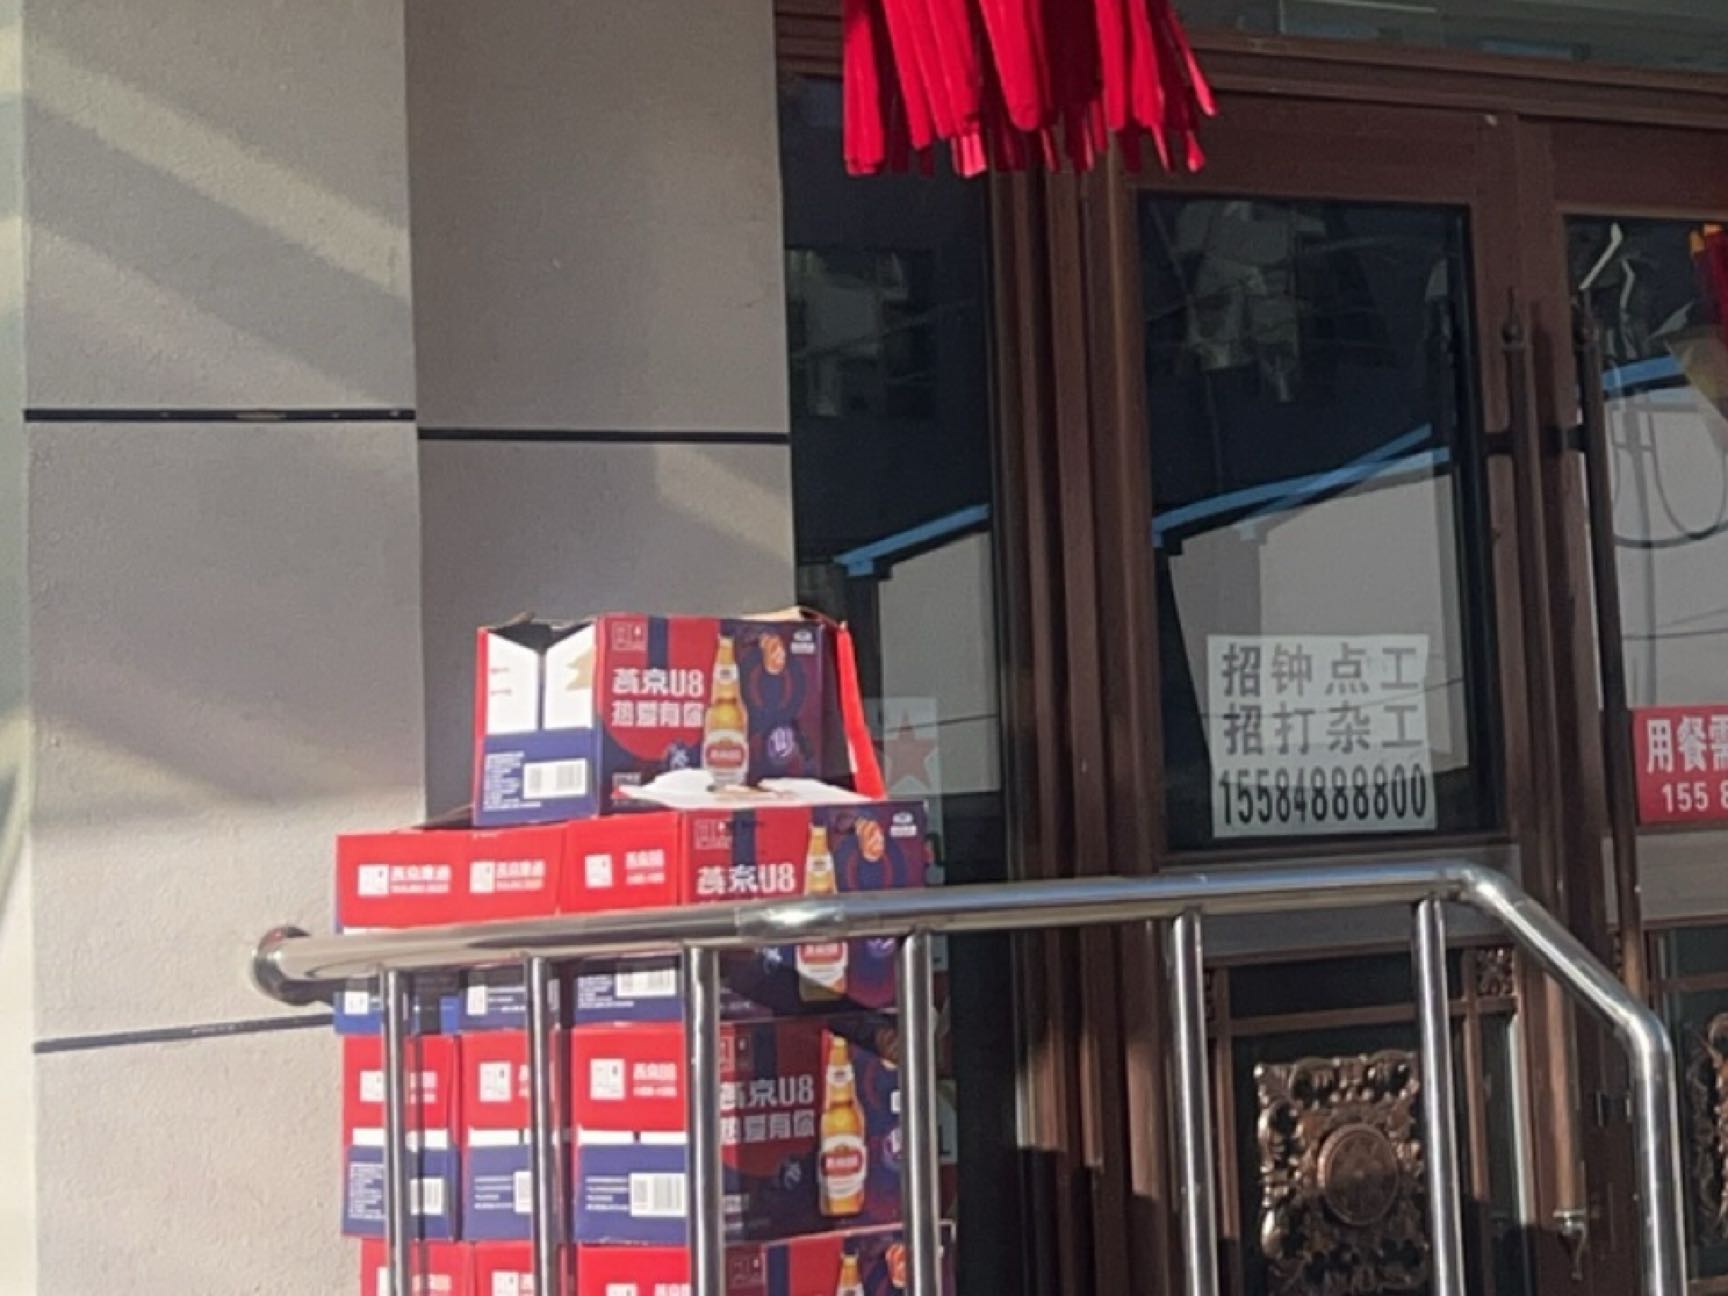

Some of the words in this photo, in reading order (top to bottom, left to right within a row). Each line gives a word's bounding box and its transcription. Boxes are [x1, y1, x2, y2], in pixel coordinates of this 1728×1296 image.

[1221, 641, 1419, 697] 招钟点工
[1223, 701, 1423, 755] 招打杂工
[1218, 762, 1427, 826] 15584888800
[1662, 782, 1709, 813] 155
